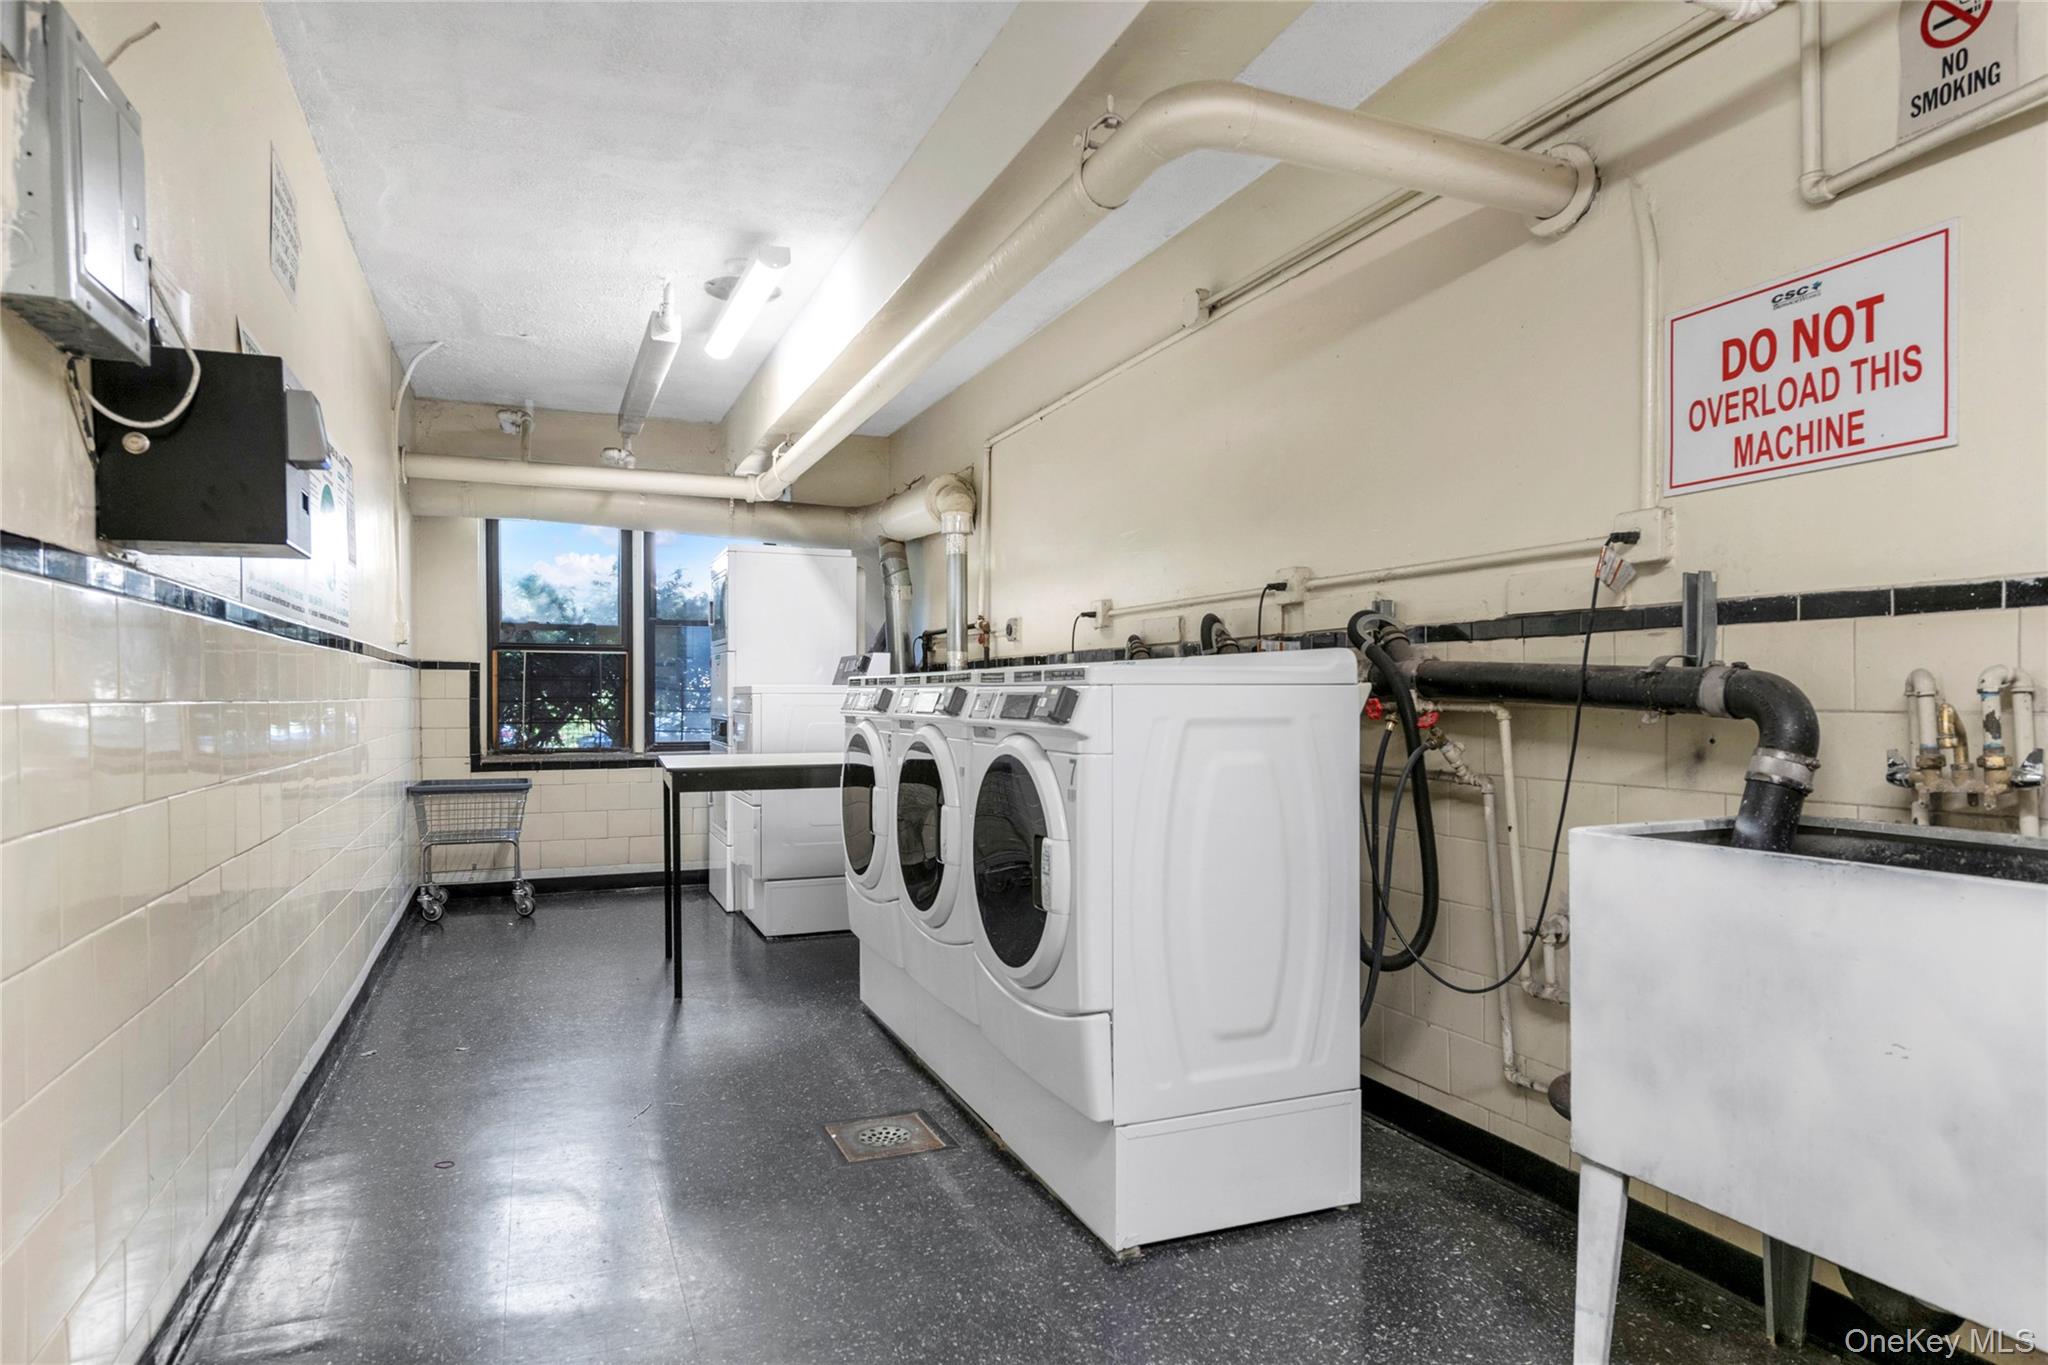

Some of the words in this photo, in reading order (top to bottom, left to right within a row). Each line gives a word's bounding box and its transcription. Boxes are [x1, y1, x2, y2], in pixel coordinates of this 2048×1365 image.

[1910, 61, 2001, 118] SMOKING
[1942, 48, 1968, 79] NO
[1771, 286, 1809, 303] CSC
[1722, 328, 1777, 382] DO
[1793, 293, 1885, 363] NOT
[1689, 366, 1840, 432] OVERLOAD
[1850, 345, 1923, 394] THIS
[1734, 409, 1865, 469] MACHINE
[1069, 758, 1077, 786] 7
